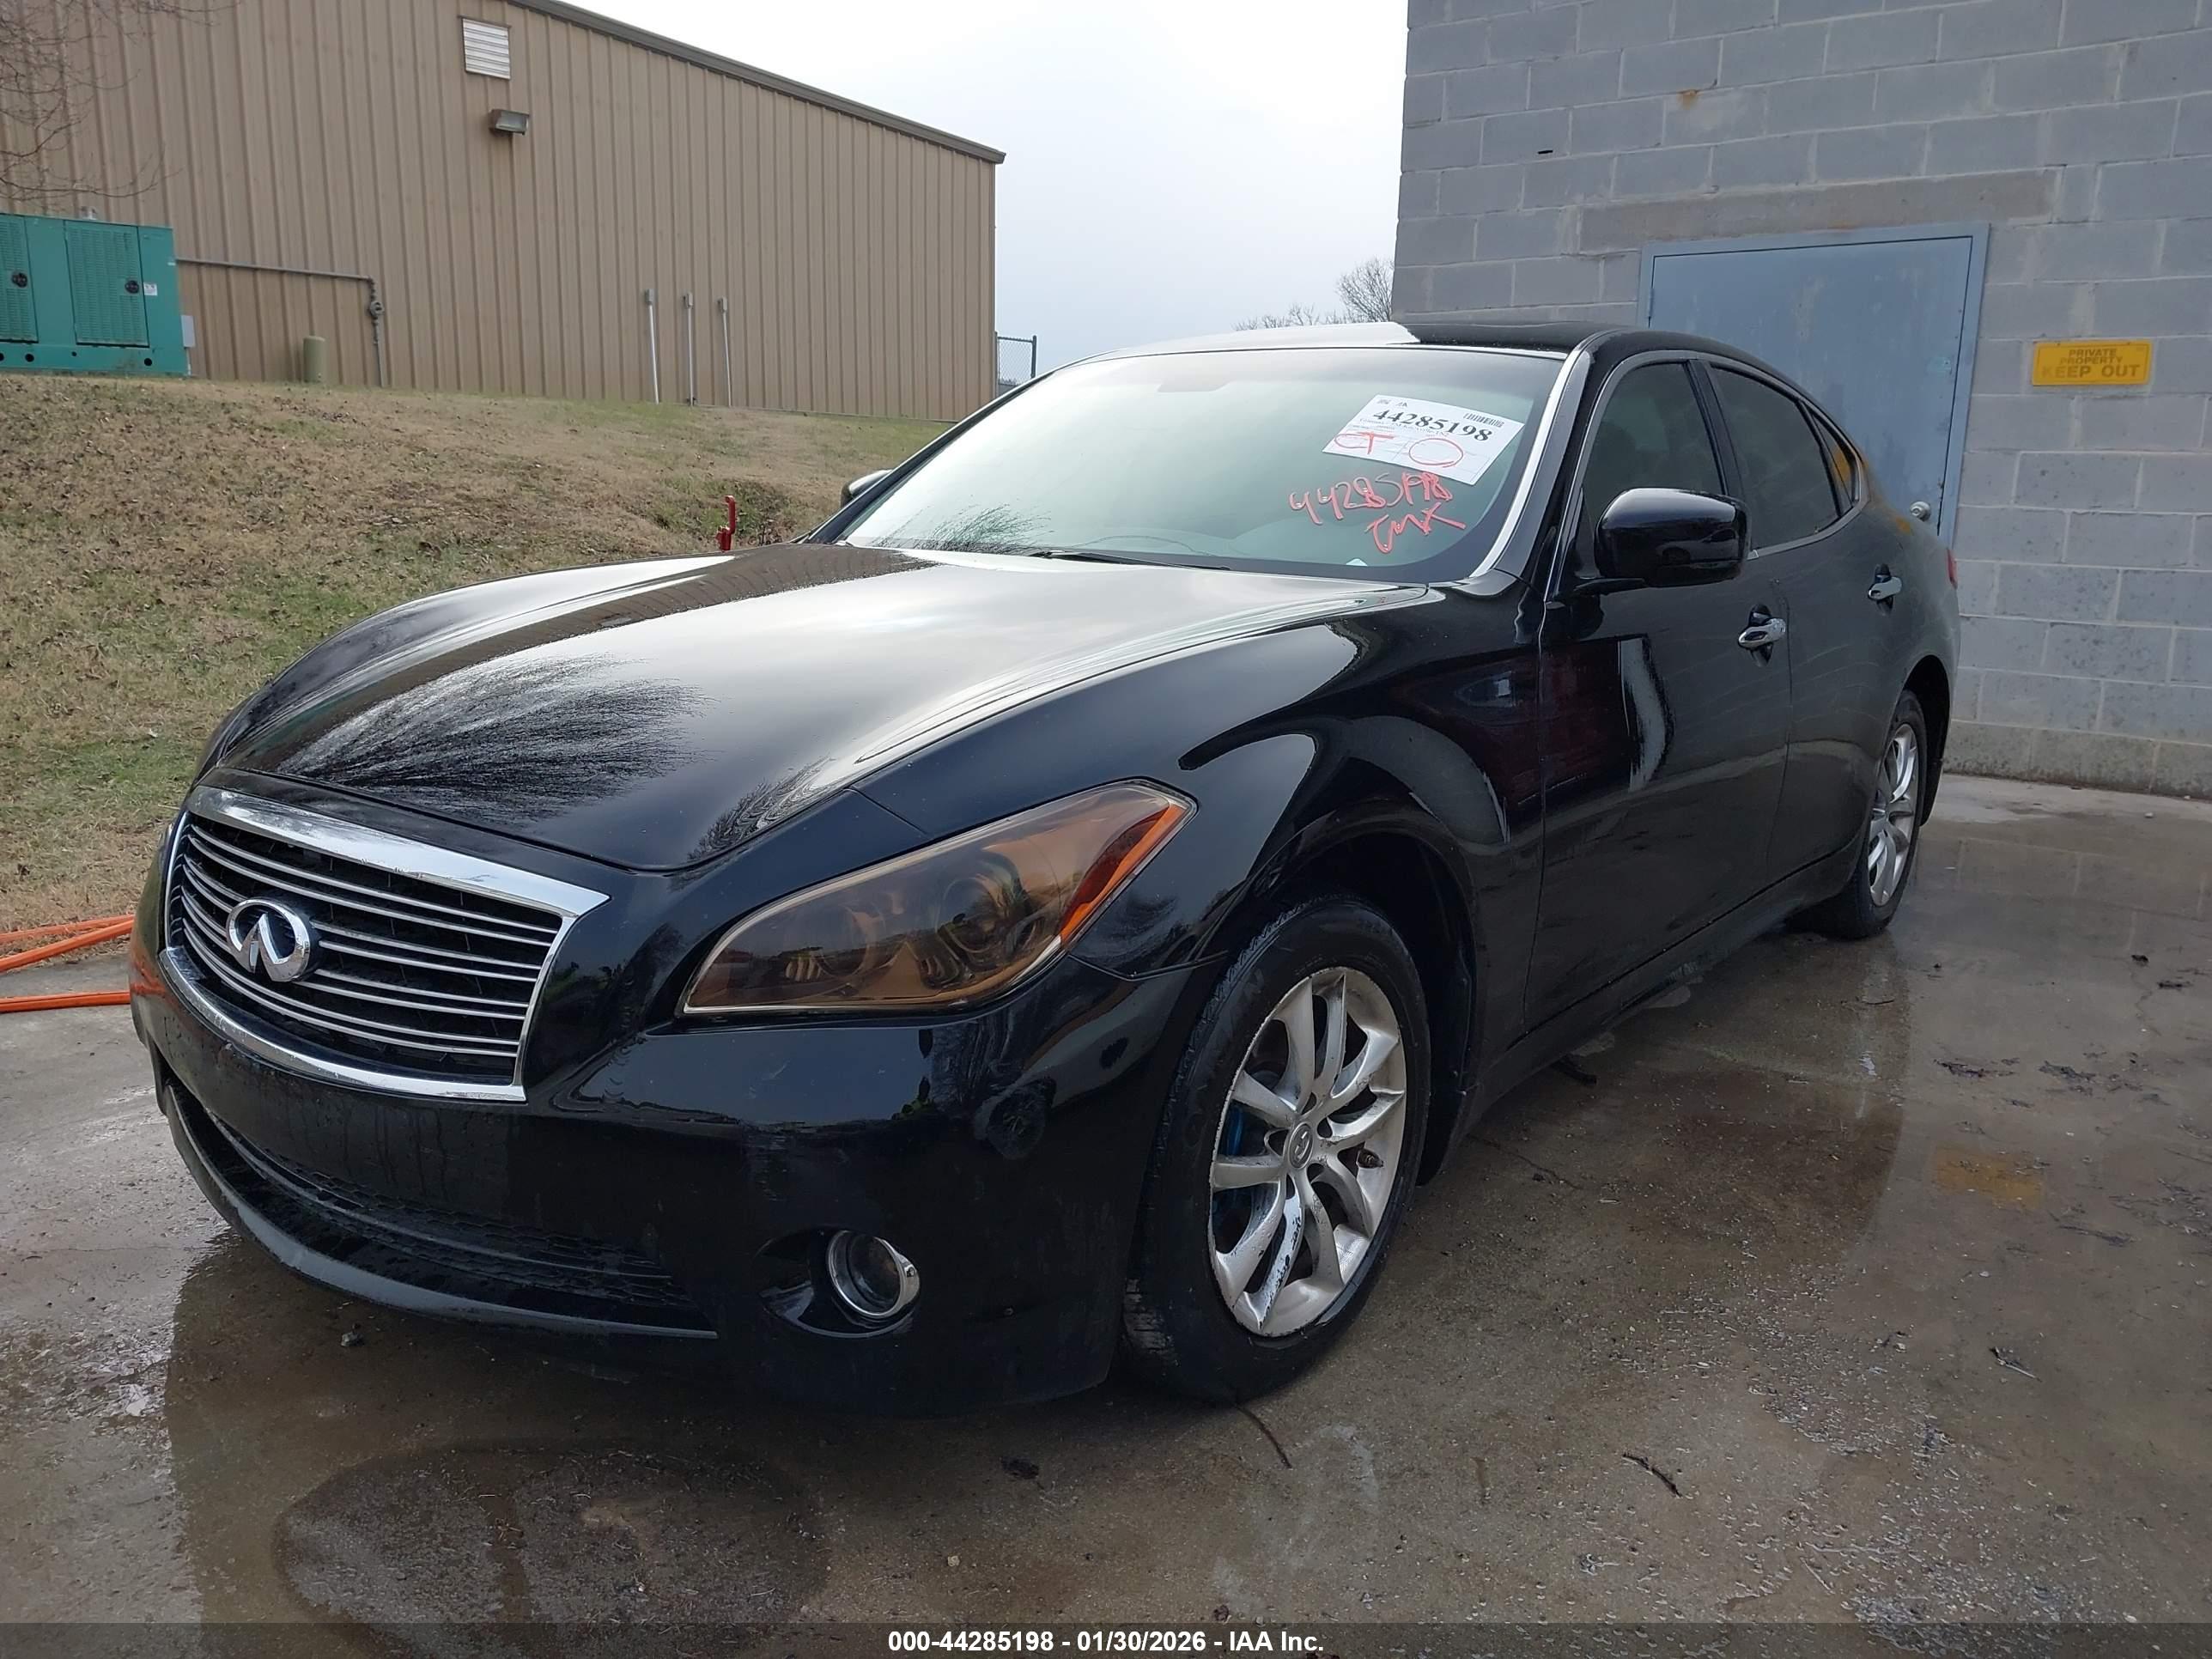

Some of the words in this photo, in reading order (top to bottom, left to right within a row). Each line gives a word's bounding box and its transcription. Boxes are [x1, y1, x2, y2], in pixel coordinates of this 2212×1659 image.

[2069, 348, 2117, 357] PRIVATE
[2060, 356, 2124, 365] PROPERTY
[2042, 365, 2091, 378] KEEP
[2101, 364, 2141, 377] OUT
[1373, 409, 1494, 441] 44285198
